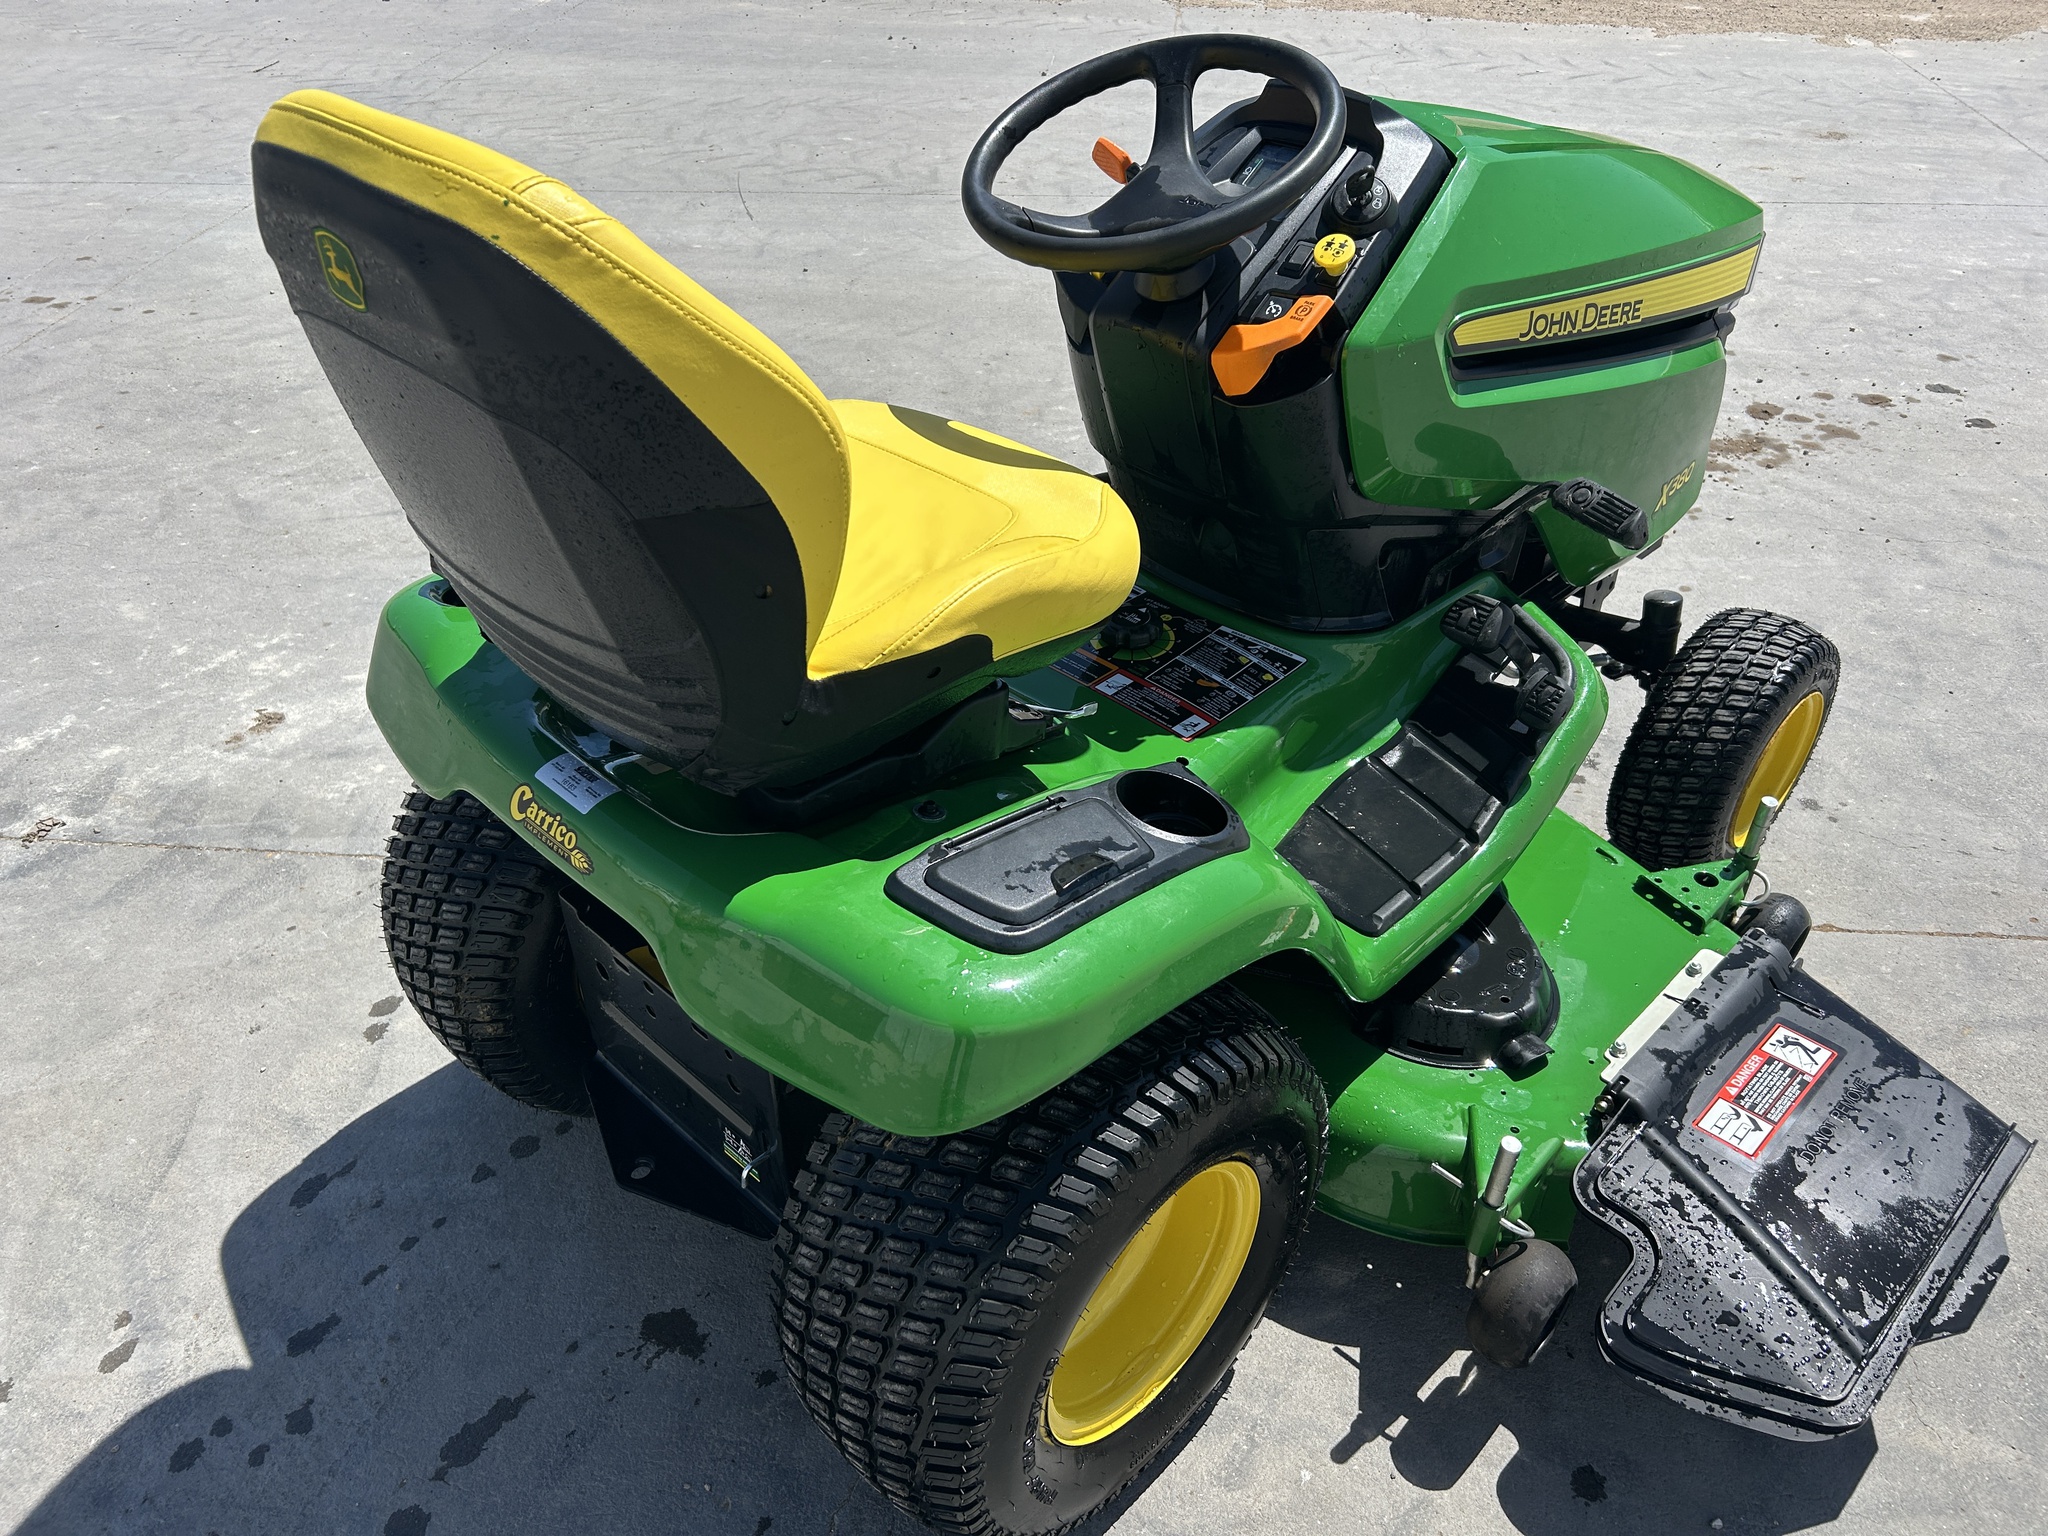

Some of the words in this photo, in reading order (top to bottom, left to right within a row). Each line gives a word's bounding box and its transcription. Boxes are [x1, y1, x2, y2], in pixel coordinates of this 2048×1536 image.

[1519, 309, 1580, 339] JOHN
[1581, 299, 1643, 330] DEERE
[1653, 460, 1696, 512] X380
[1157, 689, 1181, 704] DANGER
[510, 785, 577, 849] Carrico
[524, 821, 569, 860] IMPLEMENT
[1731, 1054, 1764, 1087] DANGER
[1799, 1142, 1822, 1164] DO
[1813, 1117, 1838, 1145] NOT
[1830, 1076, 1870, 1123] REMOVE
